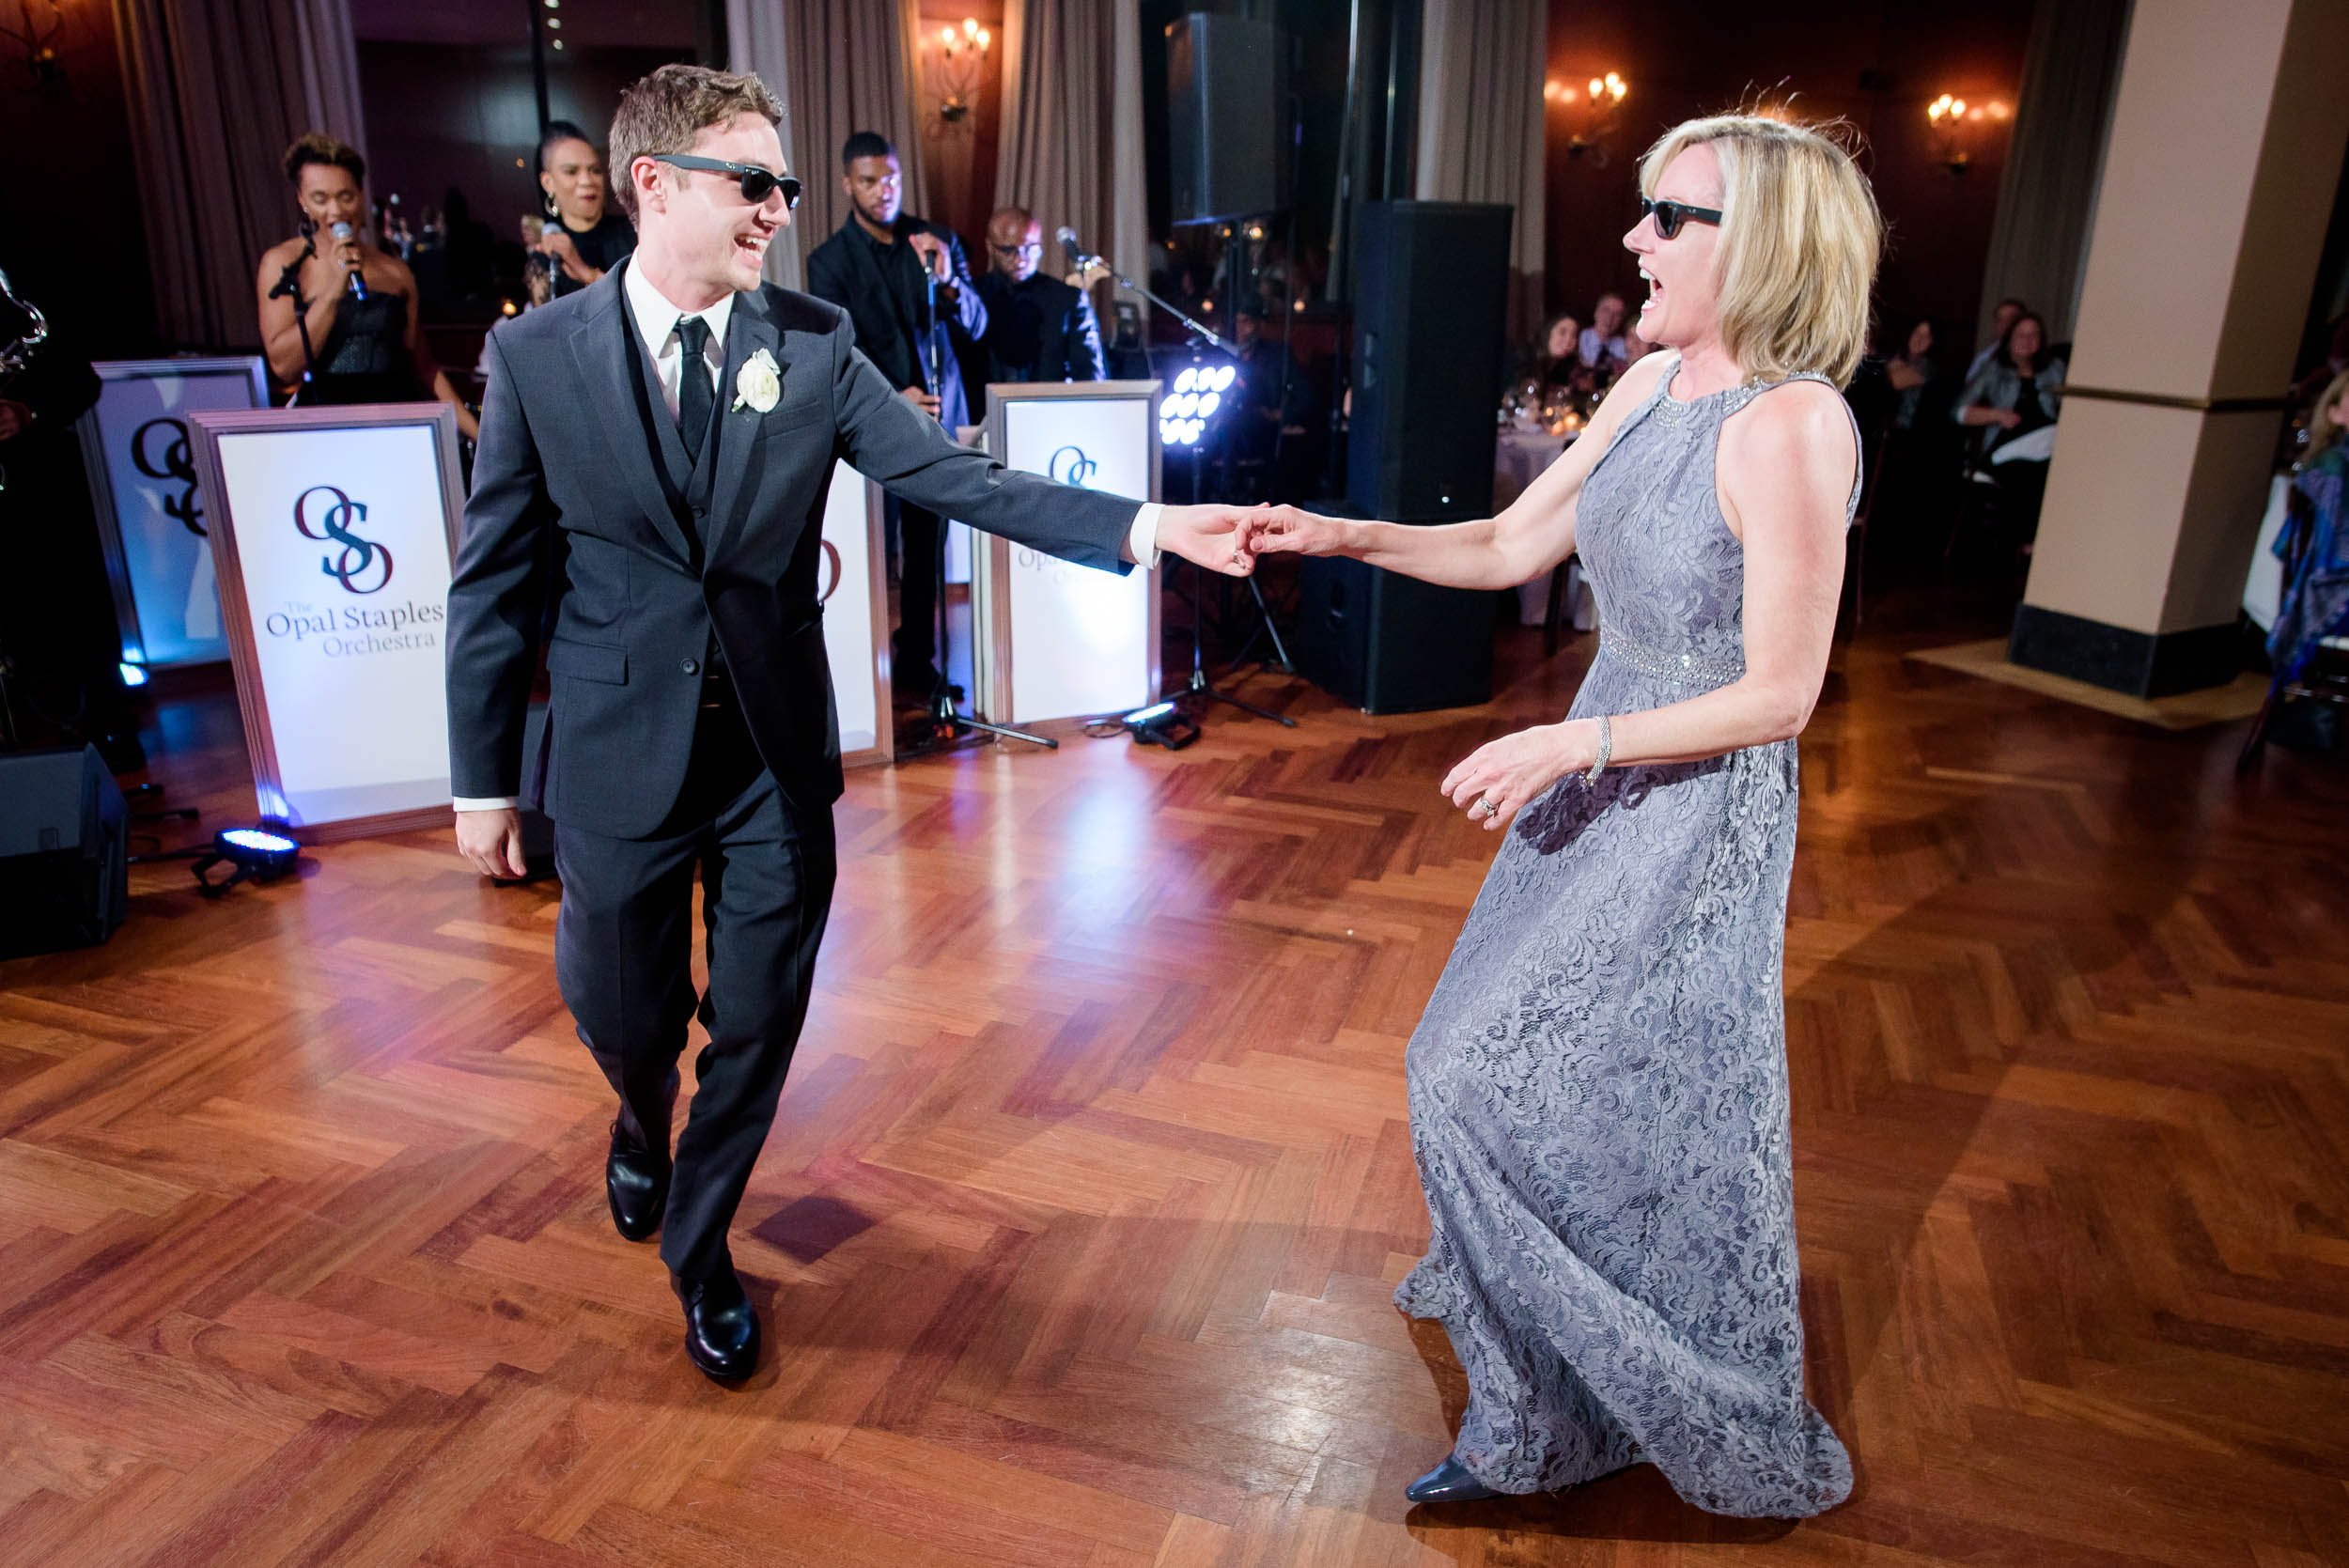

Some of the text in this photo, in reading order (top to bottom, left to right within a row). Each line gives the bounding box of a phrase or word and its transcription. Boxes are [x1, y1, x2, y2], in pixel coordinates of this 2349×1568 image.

[285, 600, 313, 613] The
[266, 601, 443, 640] Opal Staples
[323, 631, 436, 658] Orchestra
